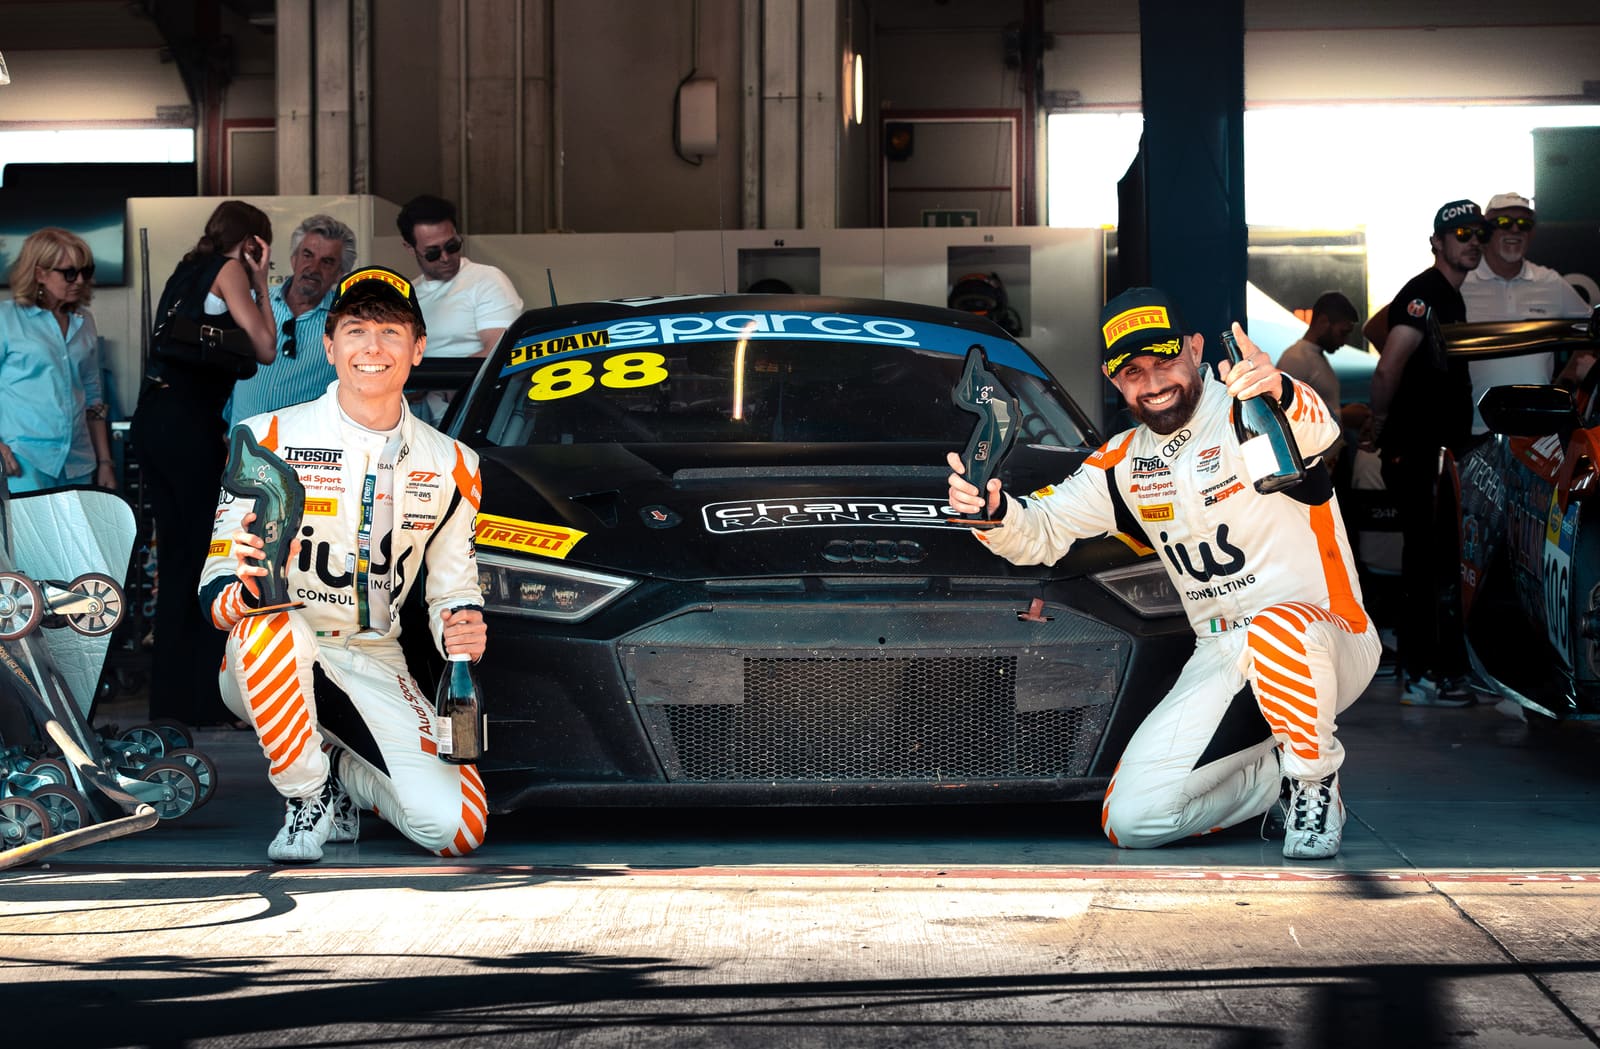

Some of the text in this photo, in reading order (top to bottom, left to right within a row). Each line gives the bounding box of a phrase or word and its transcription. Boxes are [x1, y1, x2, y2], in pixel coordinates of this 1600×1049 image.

[605, 313, 916, 344] sparco
[1106, 309, 1165, 342] PIRELLI
[528, 351, 669, 401] 88
[284, 446, 343, 463] Tresor
[1133, 456, 1169, 472] Treso
[314, 475, 342, 484] Sport
[1152, 481, 1174, 491] Sport
[722, 513, 897, 528] RACING
[265, 521, 278, 543] 3
[475, 519, 571, 552] PIRELLI
[1160, 523, 1246, 583] ius
